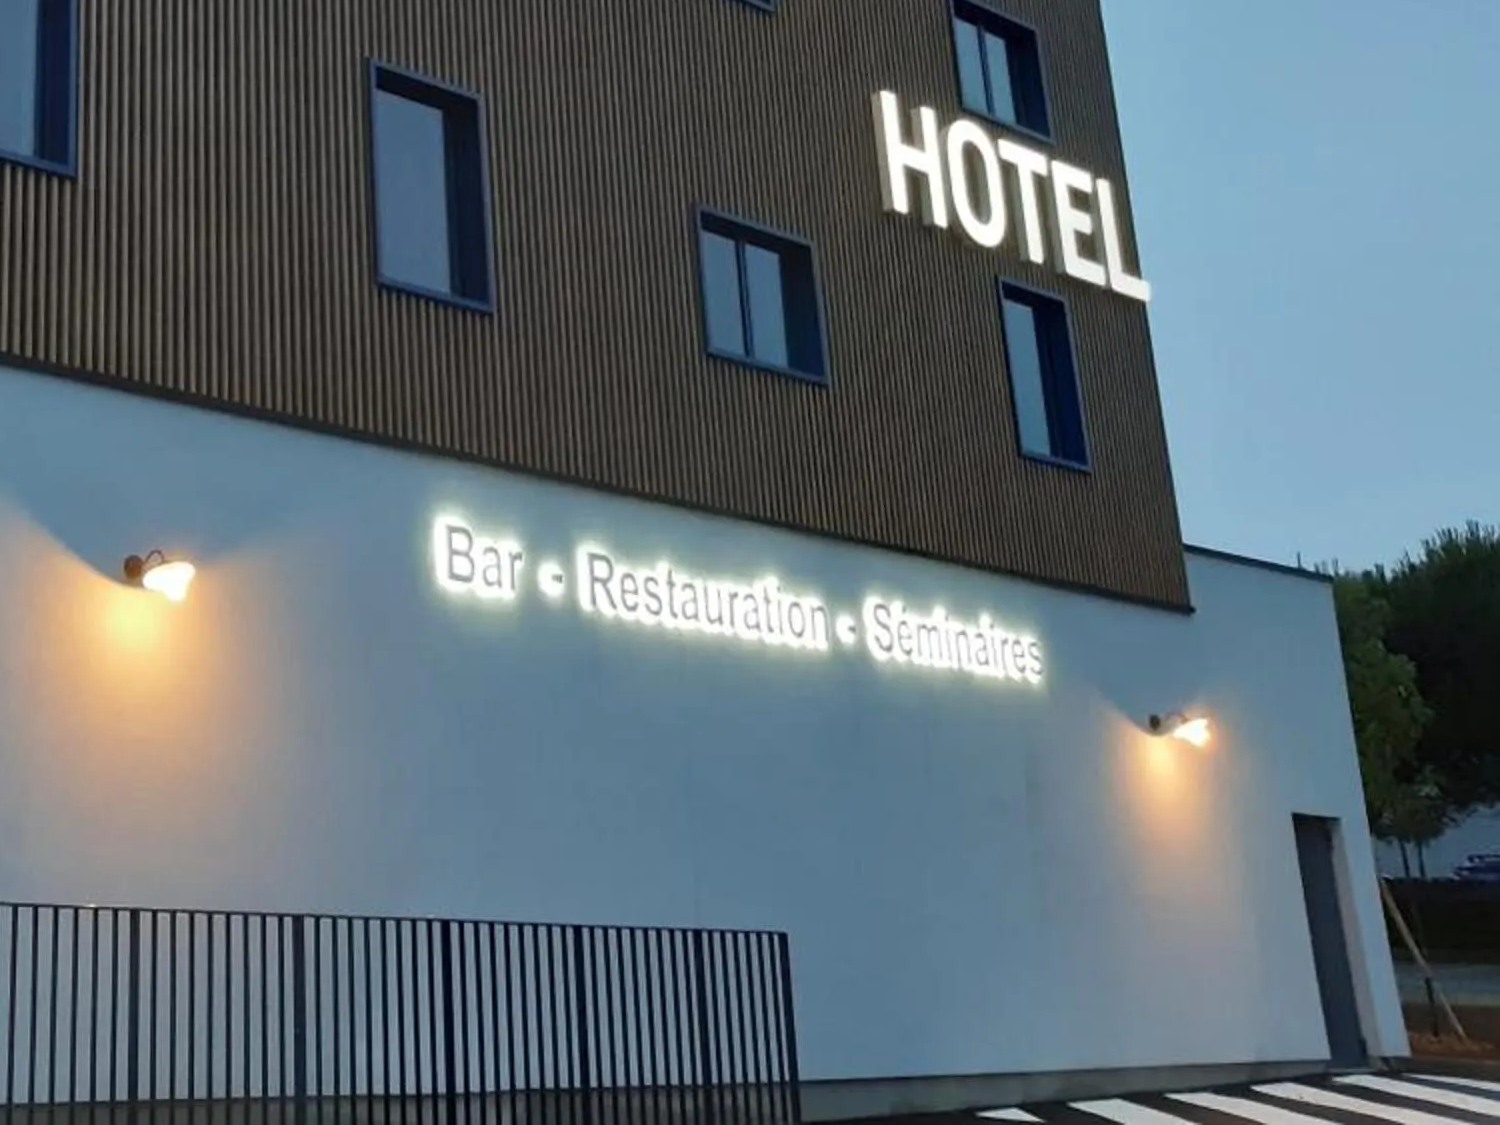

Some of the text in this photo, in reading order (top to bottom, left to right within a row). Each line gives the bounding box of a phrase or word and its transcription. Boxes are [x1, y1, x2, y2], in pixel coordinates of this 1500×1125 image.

[872, 90, 1151, 302] HOTEL
[445, 523, 523, 592] Bar
[586, 551, 831, 646] Restauration
[871, 602, 1045, 677] Séminaires
